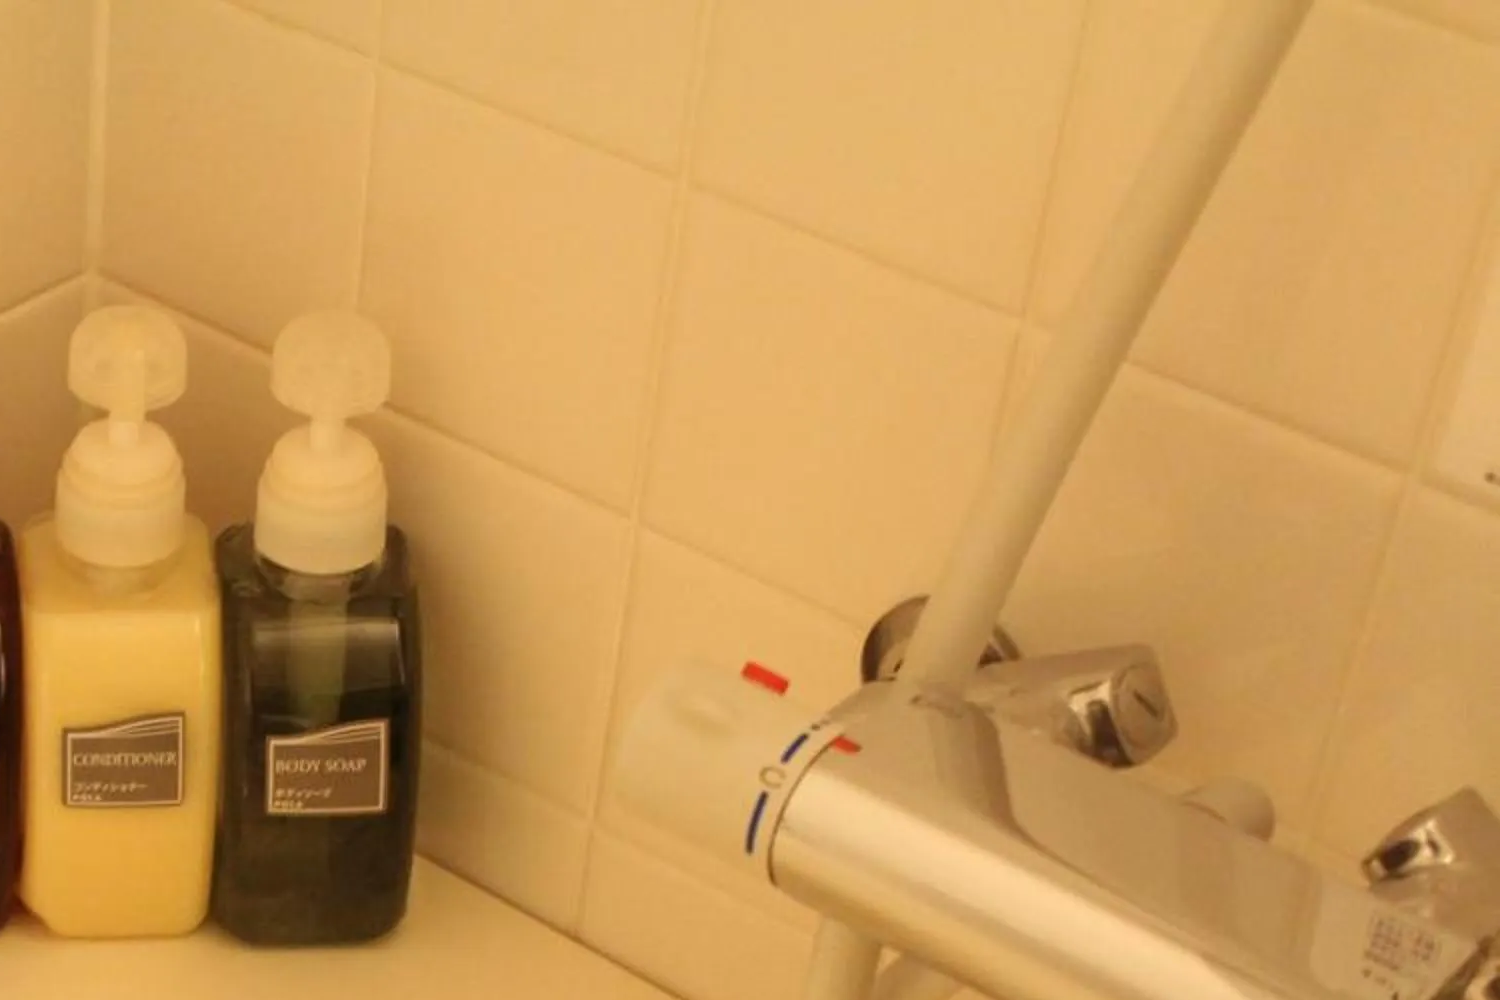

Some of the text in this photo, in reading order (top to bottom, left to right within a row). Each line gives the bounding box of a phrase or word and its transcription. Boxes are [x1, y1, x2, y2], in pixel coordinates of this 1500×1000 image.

[73, 752, 177, 767] CONDITIONER
[276, 759, 367, 773] BODY SOAP
